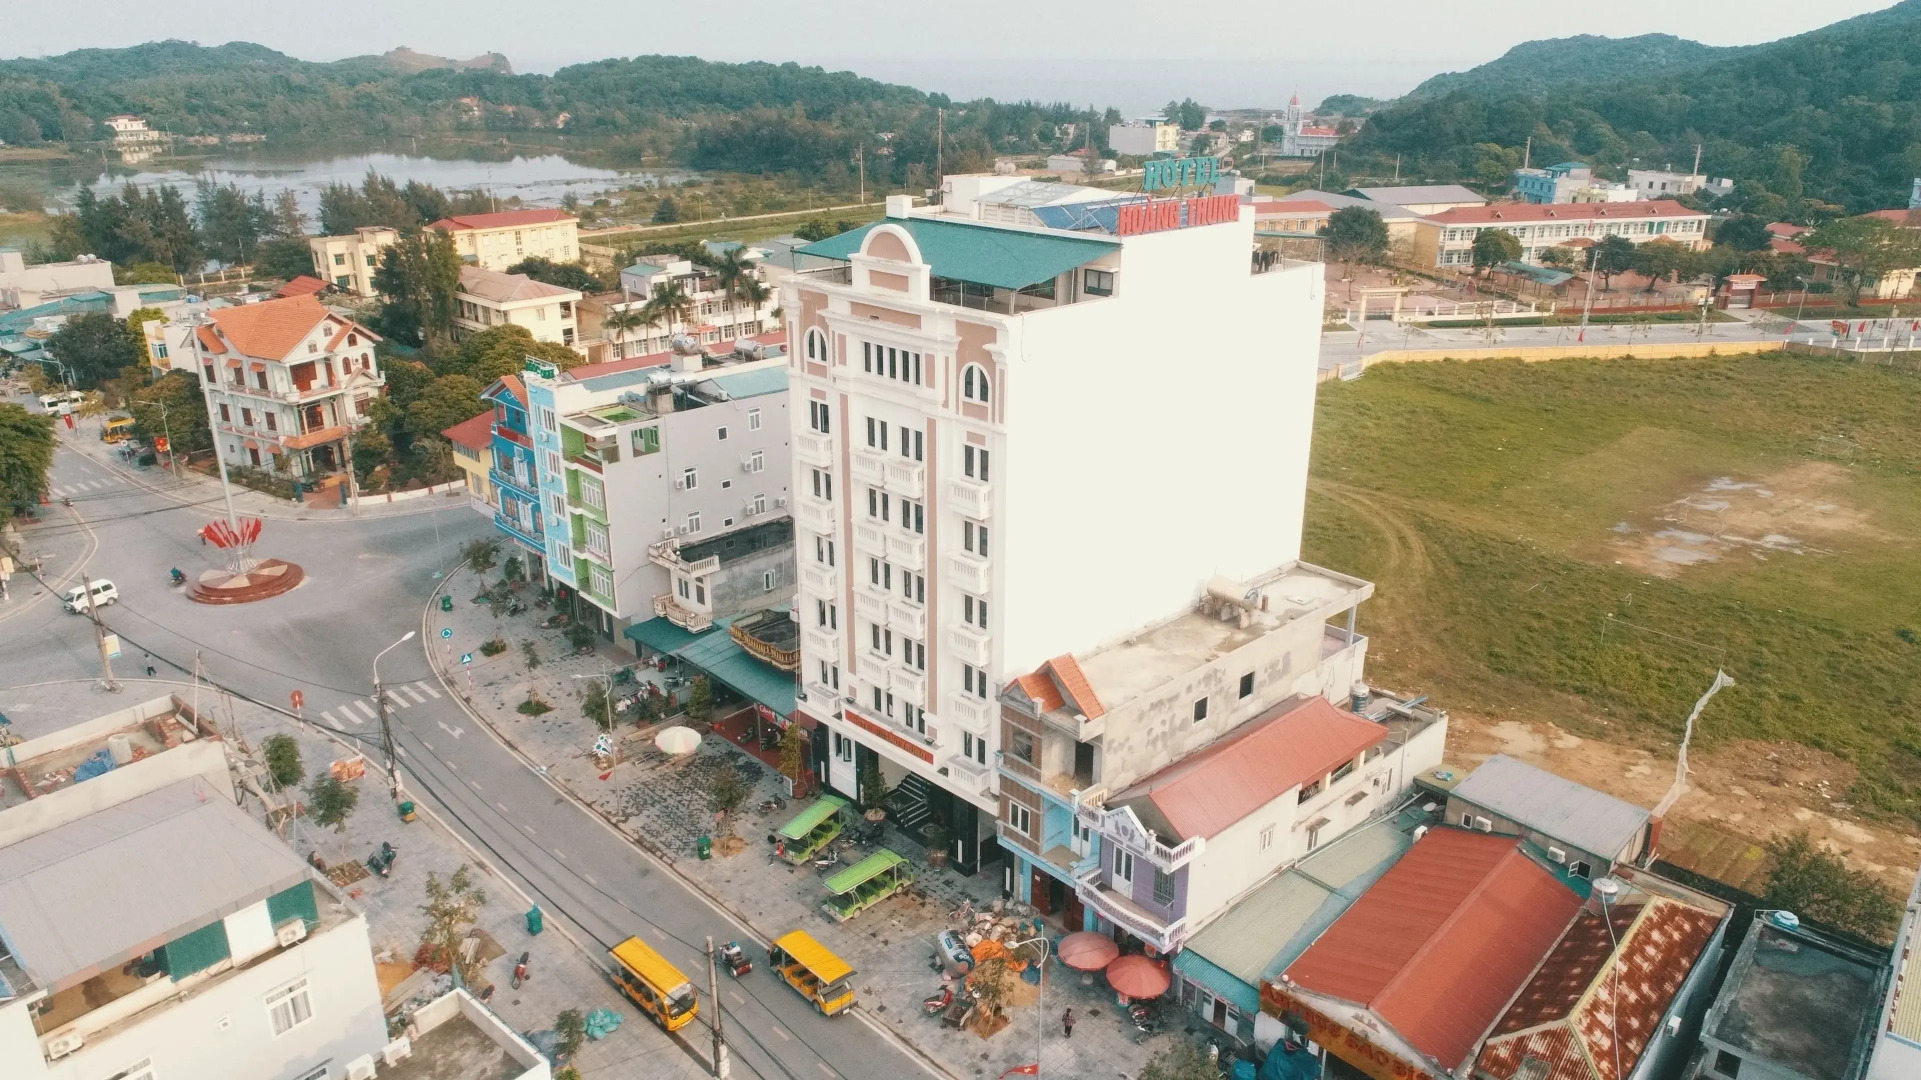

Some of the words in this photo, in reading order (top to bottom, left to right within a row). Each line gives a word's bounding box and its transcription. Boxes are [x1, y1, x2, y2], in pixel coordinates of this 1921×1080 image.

[1142, 156, 1220, 191] HOTEL
[1118, 195, 1181, 237] HOÀNG
[1187, 194, 1240, 227] TRUNG
